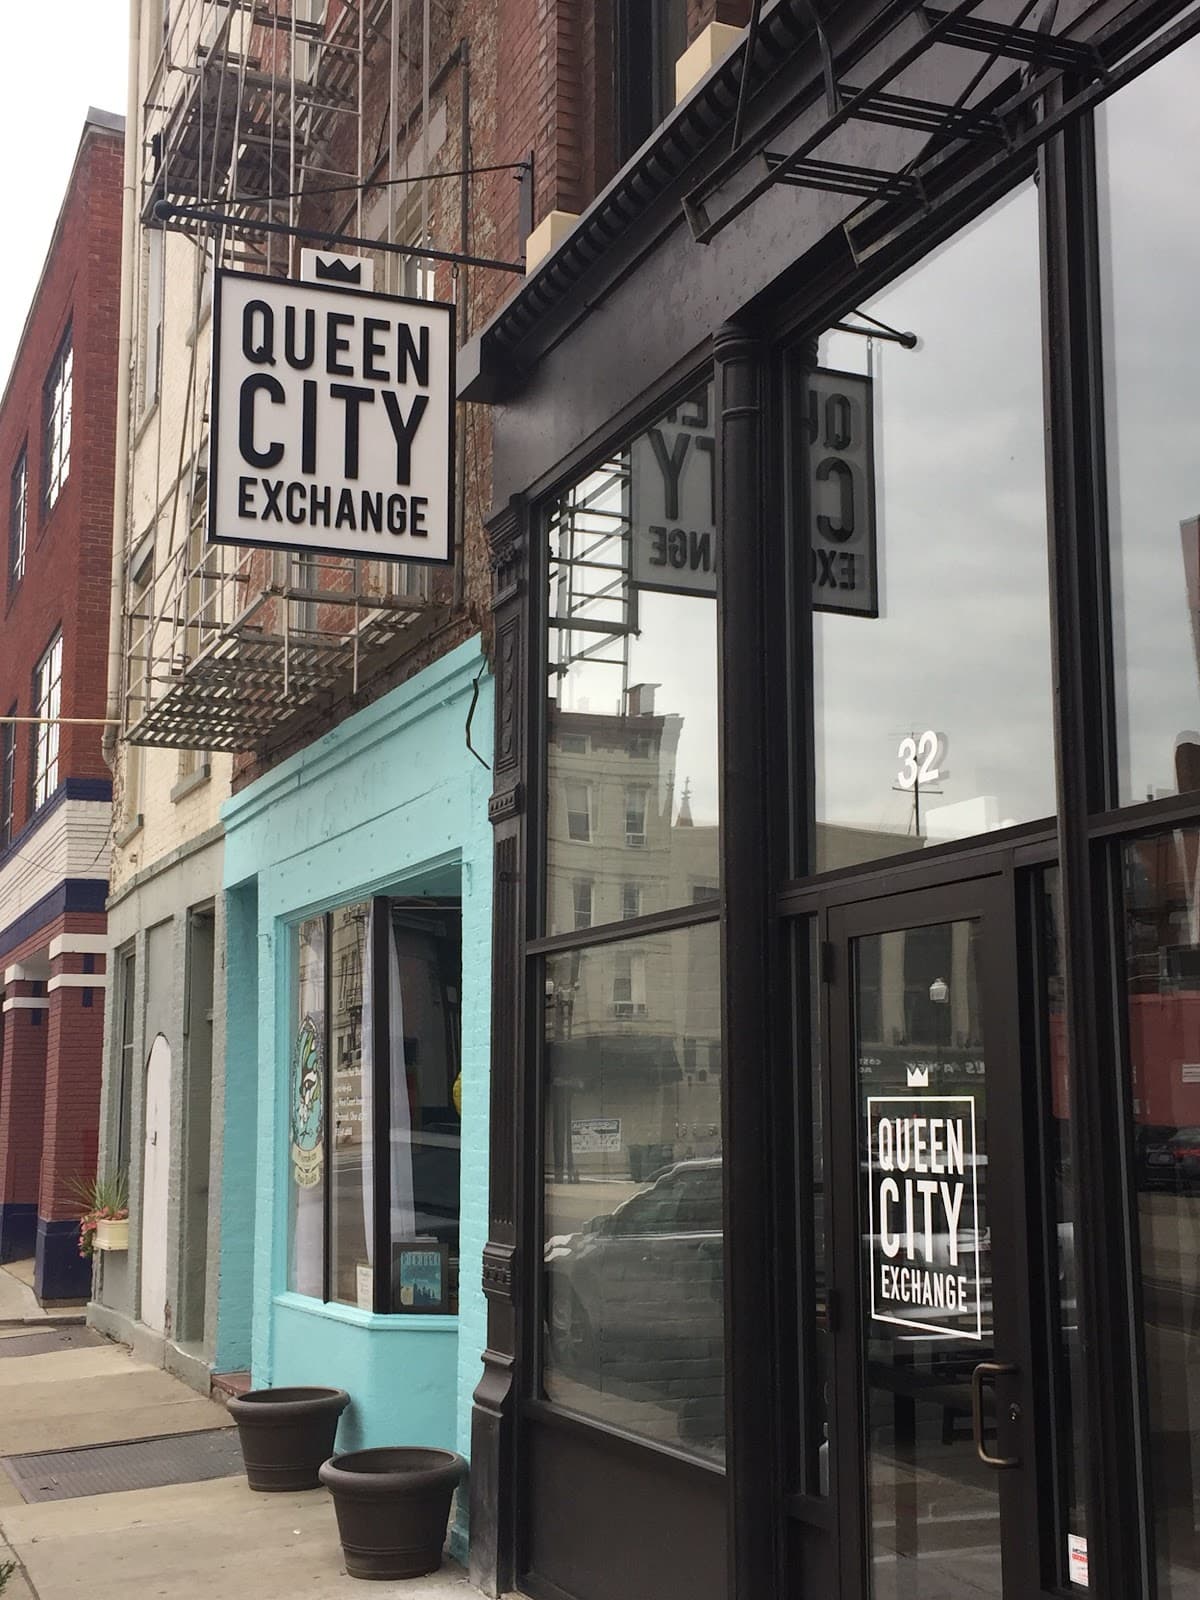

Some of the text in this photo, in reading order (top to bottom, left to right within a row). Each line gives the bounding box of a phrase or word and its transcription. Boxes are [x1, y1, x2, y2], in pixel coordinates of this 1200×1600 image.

[242, 300, 430, 388] QUEEN
[239, 373, 430, 488] CITY
[238, 476, 429, 538] EXCHANGE
[898, 730, 939, 788] 32
[878, 1117, 964, 1175] QUEEN
[880, 1177, 964, 1266] CITY
[881, 1264, 968, 1313] EXCHANGE
